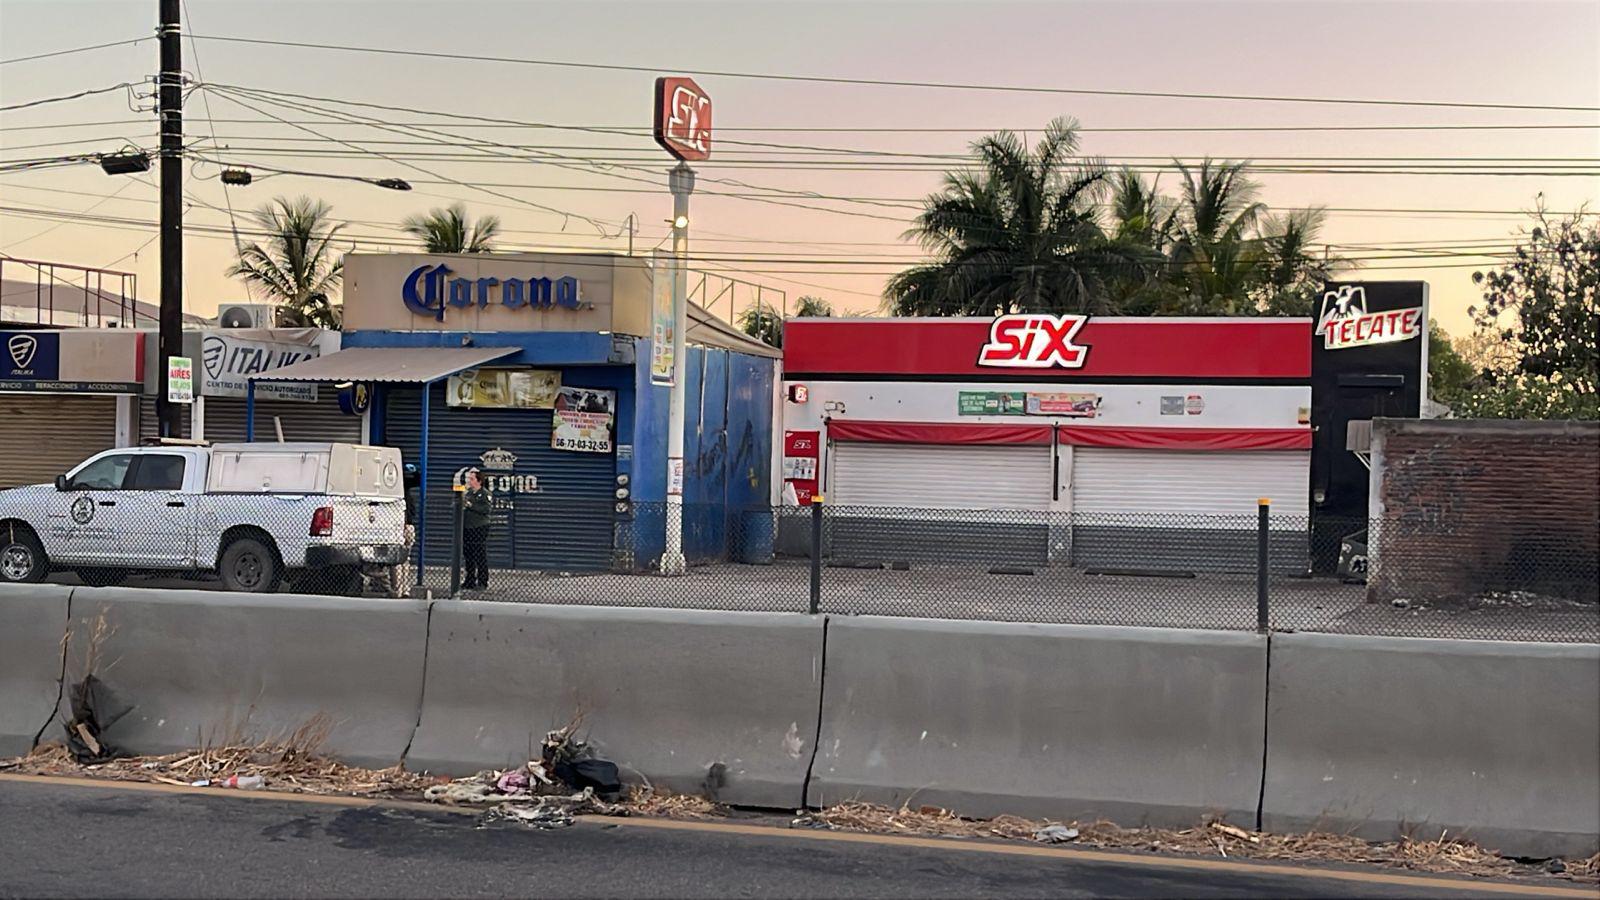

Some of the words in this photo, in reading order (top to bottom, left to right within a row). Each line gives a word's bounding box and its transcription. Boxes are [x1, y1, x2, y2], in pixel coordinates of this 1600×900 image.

[402, 263, 584, 322] Corona
[1323, 310, 1418, 344] TECATE
[170, 369, 191, 380] AIRES
[206, 381, 233, 389] CENTRO
